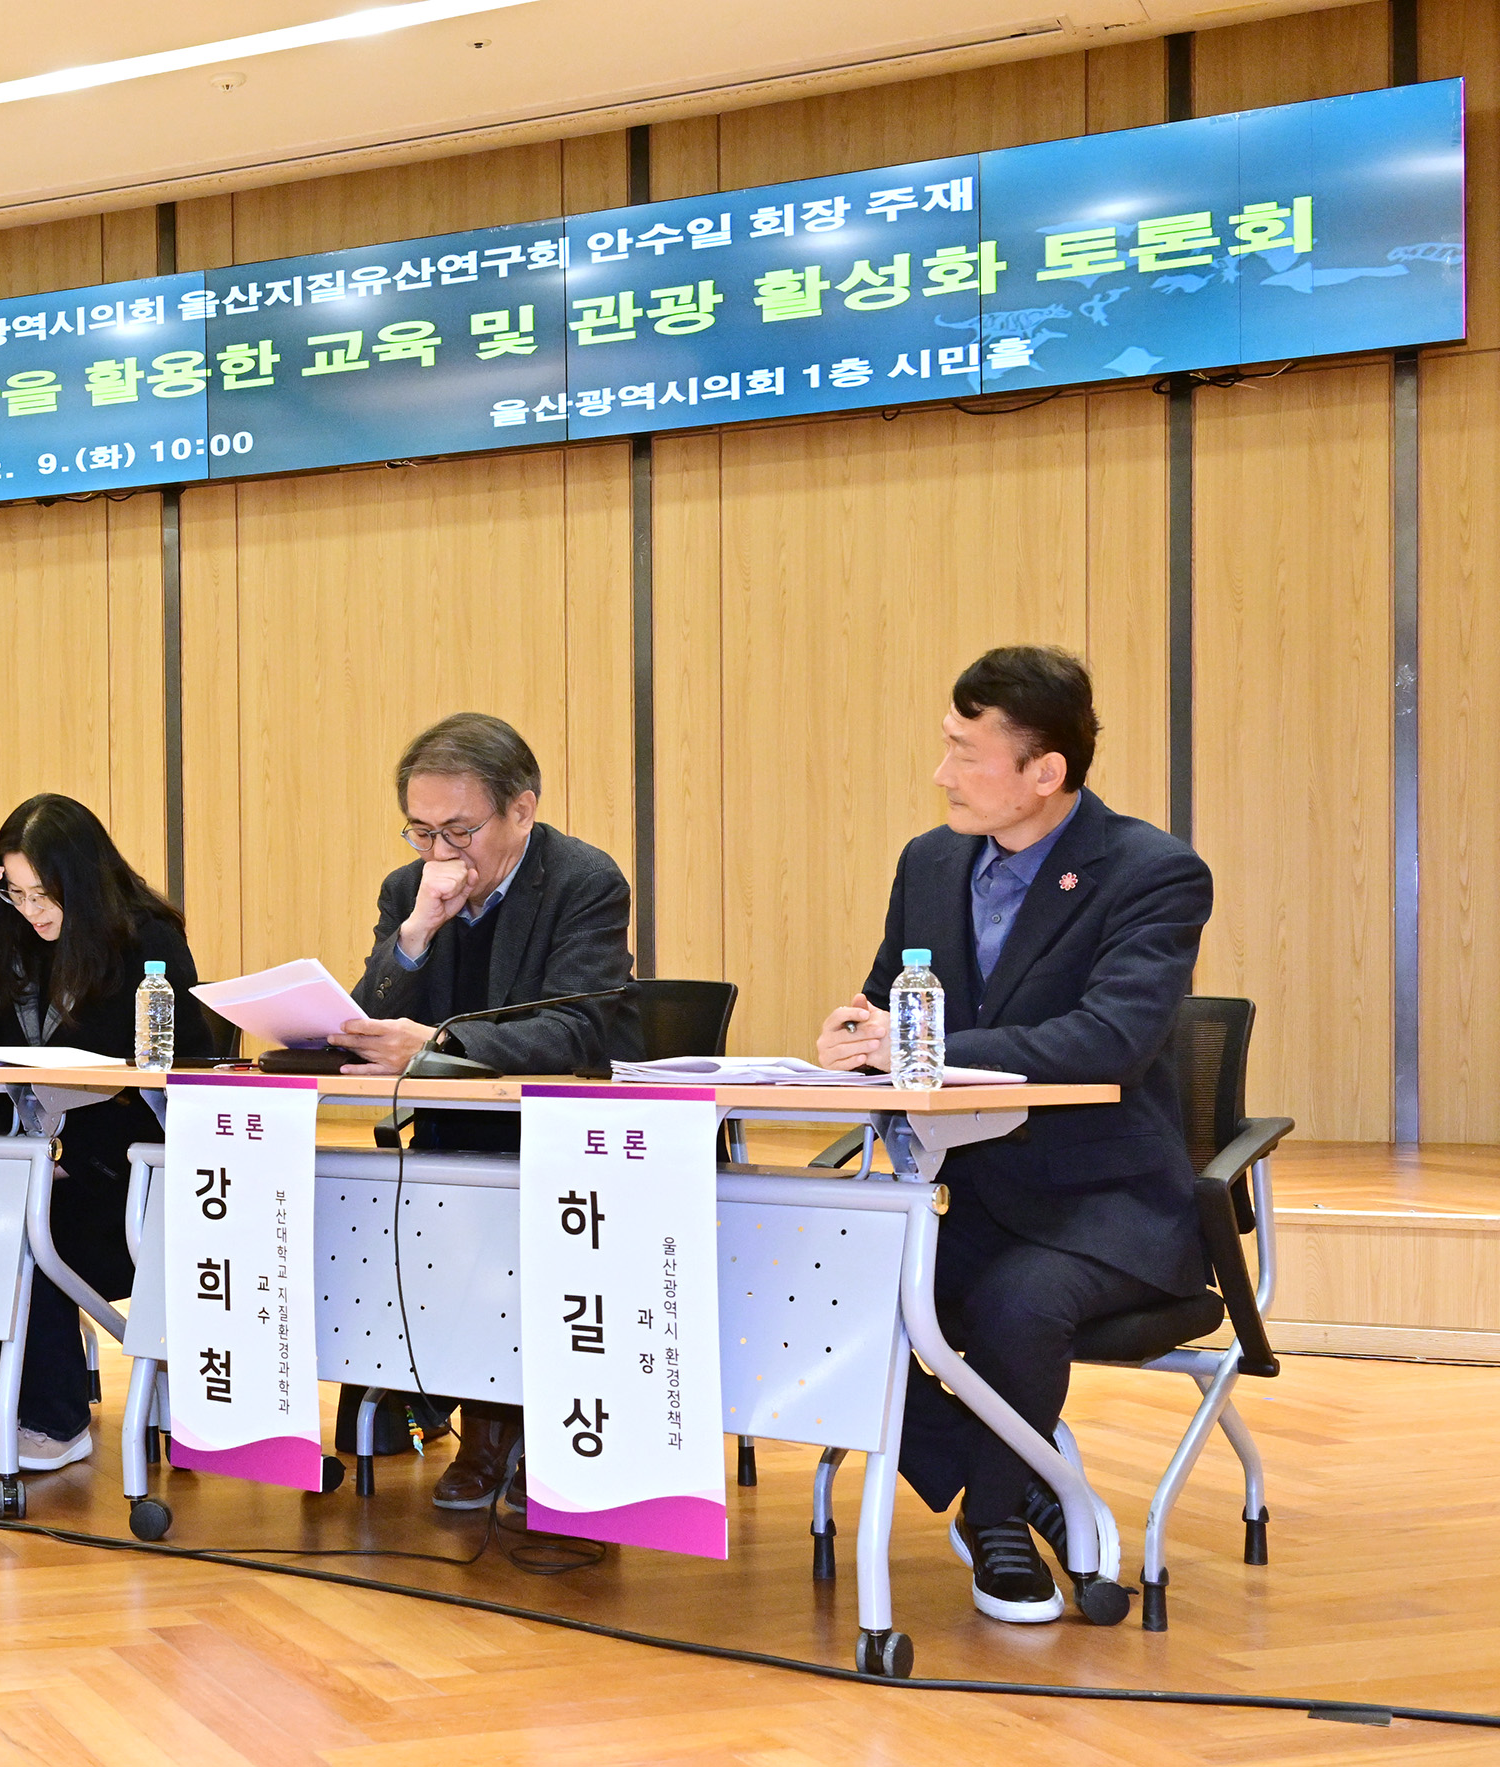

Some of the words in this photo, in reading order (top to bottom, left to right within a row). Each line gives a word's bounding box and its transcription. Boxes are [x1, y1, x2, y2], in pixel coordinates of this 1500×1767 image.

[84, 339, 281, 407] 활용한
[301, 319, 443, 378] 교육
[469, 303, 538, 361] 및
[568, 279, 724, 347] 관광
[752, 240, 1008, 324] 활성화
[1037, 195, 1314, 283] 토론회
[177, 236, 570, 320] 울산지질유산연구회
[586, 212, 733, 264] 안수일
[749, 196, 851, 239] 회장
[865, 177, 975, 223] 주재
[489, 366, 785, 429] 울산광역시의회
[802, 356, 874, 391] 1층
[886, 337, 1035, 381] 시민홀
[150, 430, 254, 462] 10:00
[275, 1189, 288, 1279] 부산대학교
[662, 1236, 678, 1341] 울산광역시
[277, 1287, 291, 1415] 지질환경과학과
[665, 1346, 683, 1451] 환경정책과
